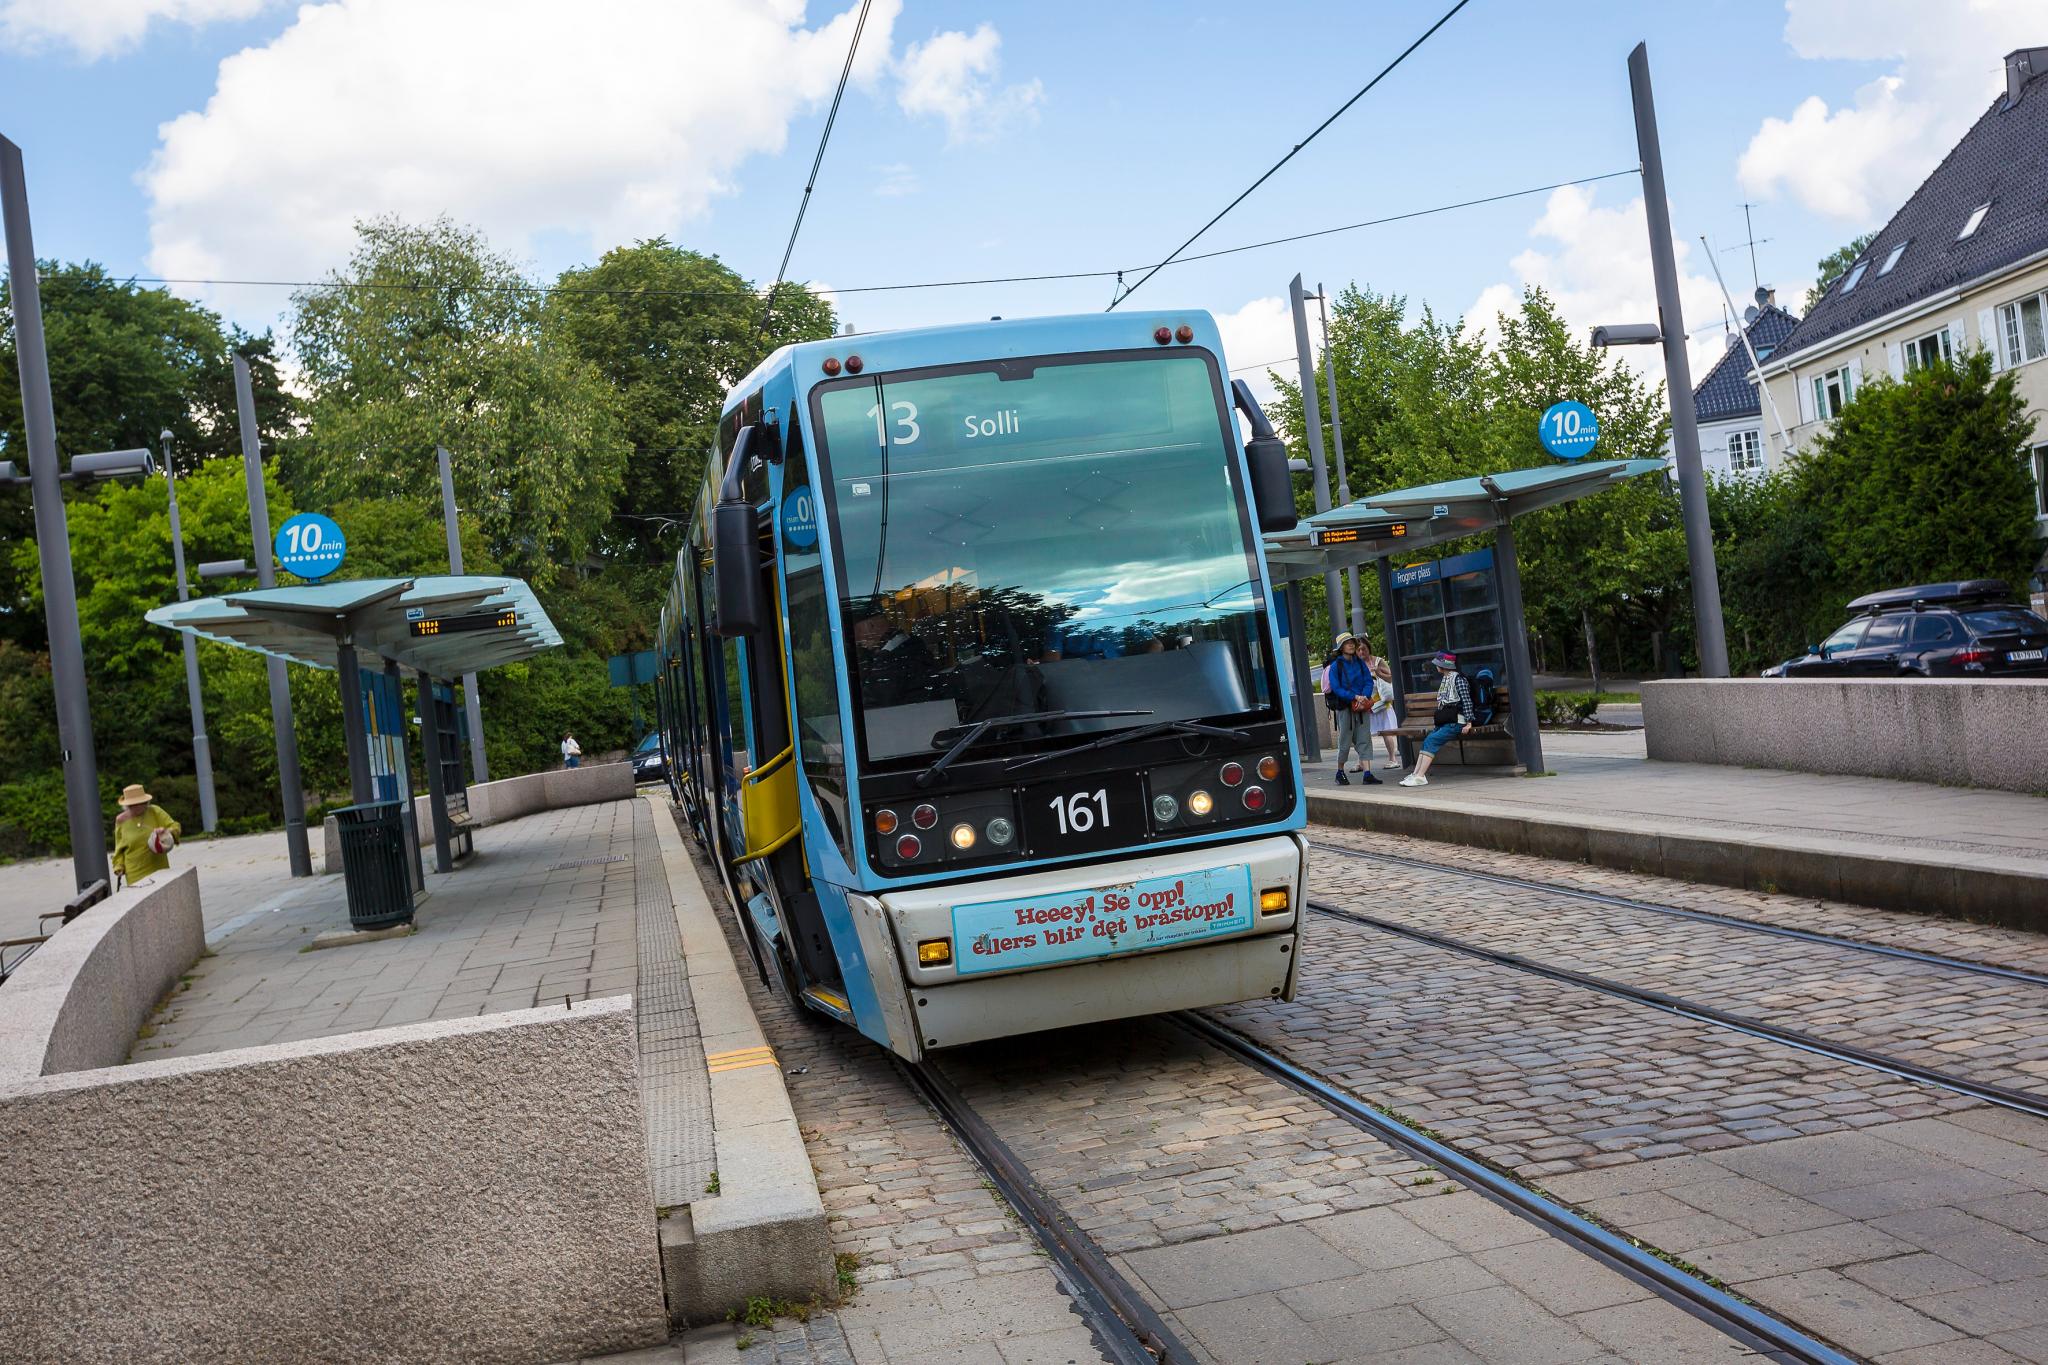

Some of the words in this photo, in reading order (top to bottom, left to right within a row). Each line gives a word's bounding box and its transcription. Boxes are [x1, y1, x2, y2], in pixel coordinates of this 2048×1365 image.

[866, 401, 920, 447] 13
[964, 409, 1019, 438] Solli
[1552, 410, 1580, 437] 10
[1580, 425, 1596, 434] min
[286, 523, 322, 554] 10
[321, 540, 342, 550] min
[1397, 571, 1417, 584] Frogner
[1417, 566, 1431, 581] plass
[1049, 788, 1110, 834] 161
[972, 933, 1037, 955] ellers
[1043, 926, 1085, 945] blir
[1092, 917, 1128, 937] det
[1134, 893, 1235, 930] bråstopp!
[1014, 896, 1096, 925] Heeey!
[1103, 893, 1131, 912] Se
[1138, 880, 1185, 911] opp!
